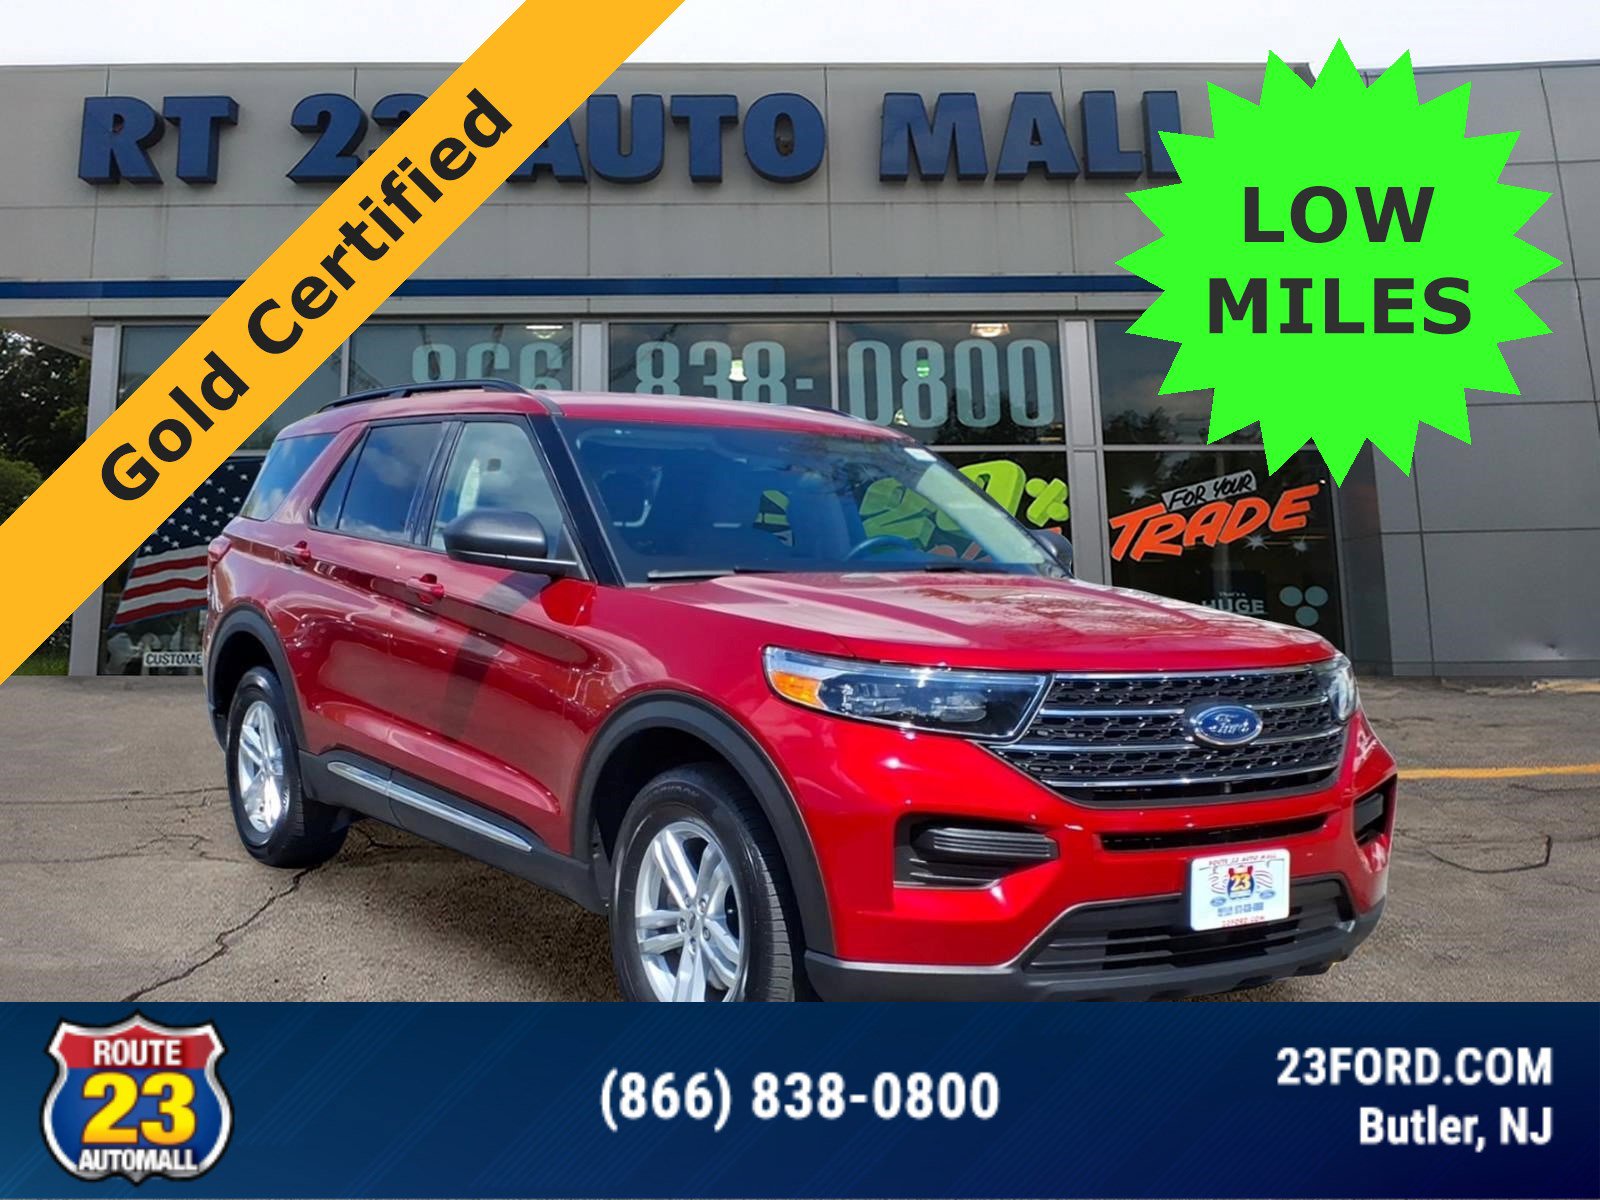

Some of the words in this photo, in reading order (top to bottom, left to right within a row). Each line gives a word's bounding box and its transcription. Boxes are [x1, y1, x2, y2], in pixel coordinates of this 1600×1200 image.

[78, 96, 240, 185] RT
[1168, 485, 1207, 509] FOR
[1213, 475, 1253, 499] YOUR
[1109, 484, 1320, 562] TRADE
[1202, 599, 1265, 615] HUGE
[1208, 713, 1250, 735] Ford
